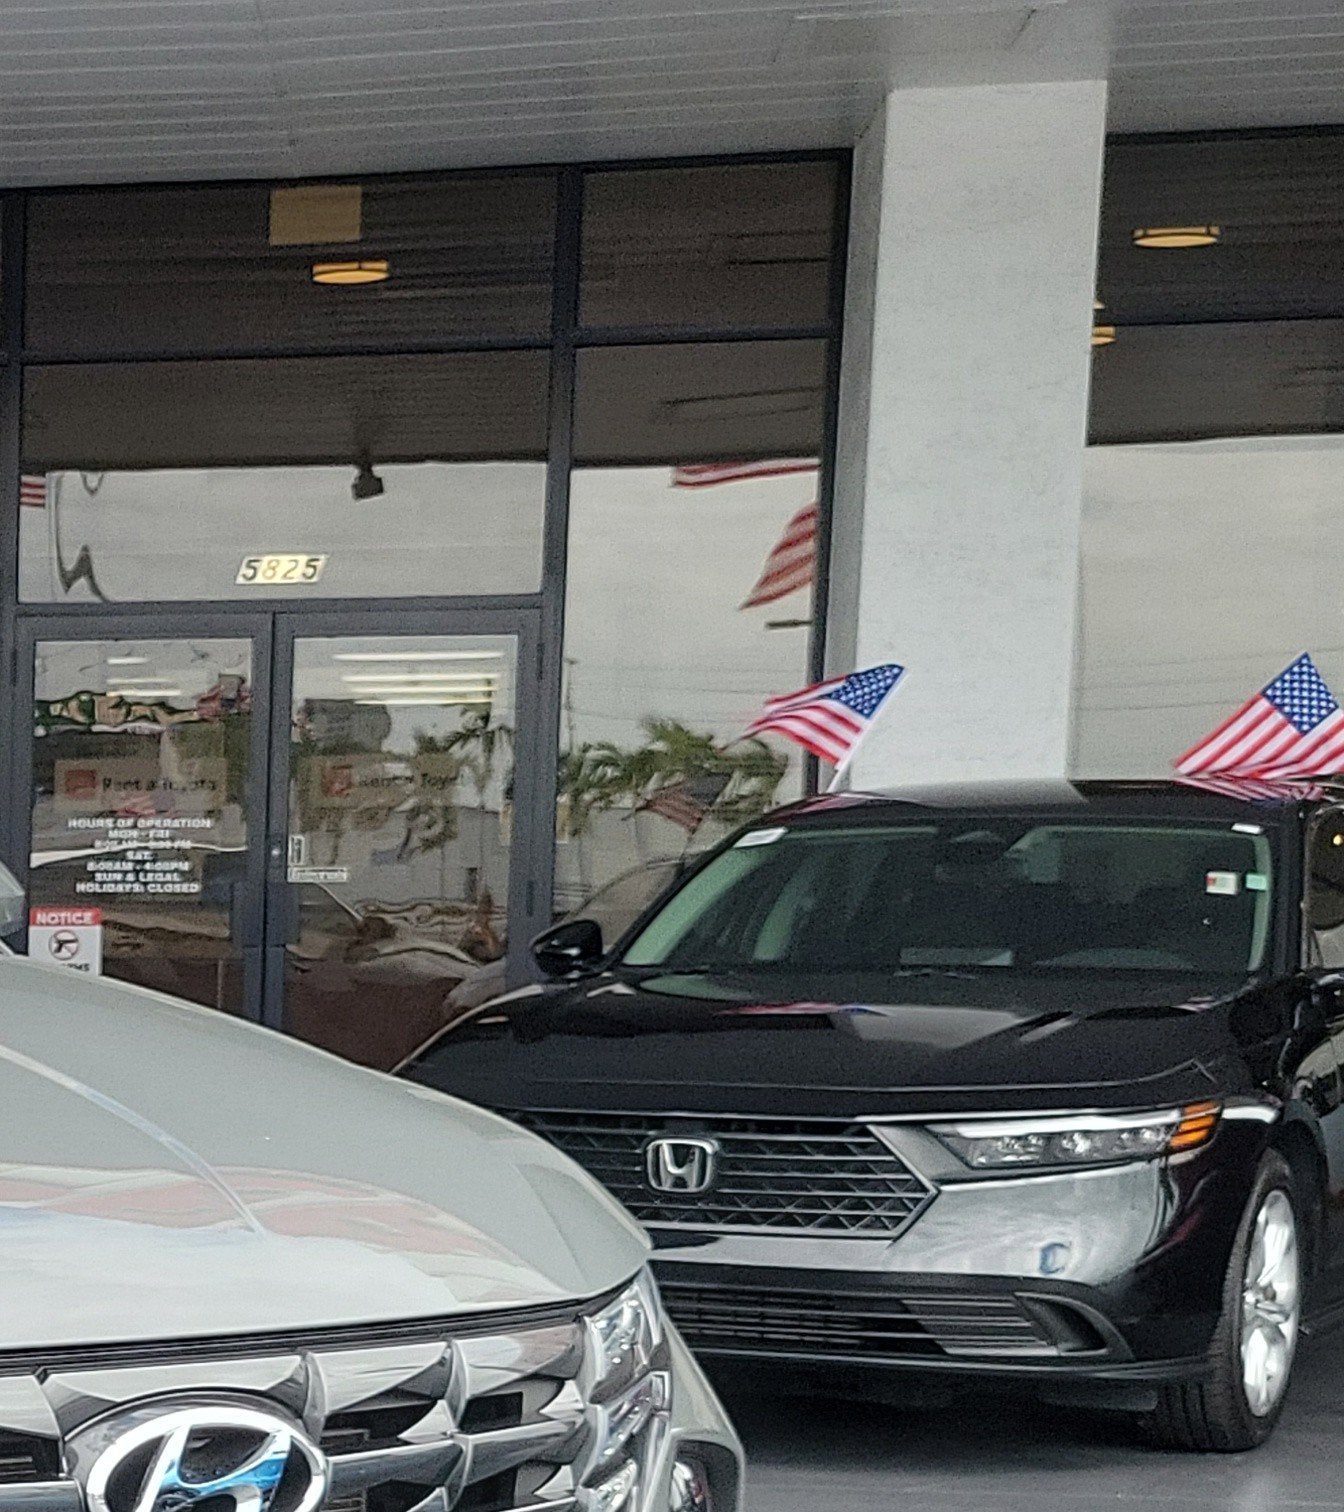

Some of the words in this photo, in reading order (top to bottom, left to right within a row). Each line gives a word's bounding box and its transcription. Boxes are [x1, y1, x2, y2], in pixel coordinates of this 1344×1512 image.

[242, 558, 320, 581] 5825
[67, 817, 115, 829] HOURS
[116, 818, 135, 828] OF
[137, 817, 212, 829] OPERATION
[108, 829, 139, 839] MON
[94, 872, 123, 882] SUN
[138, 872, 181, 882] LEGAL
[146, 882, 201, 894] CLOSED
[36, 911, 93, 925] NOTICE
